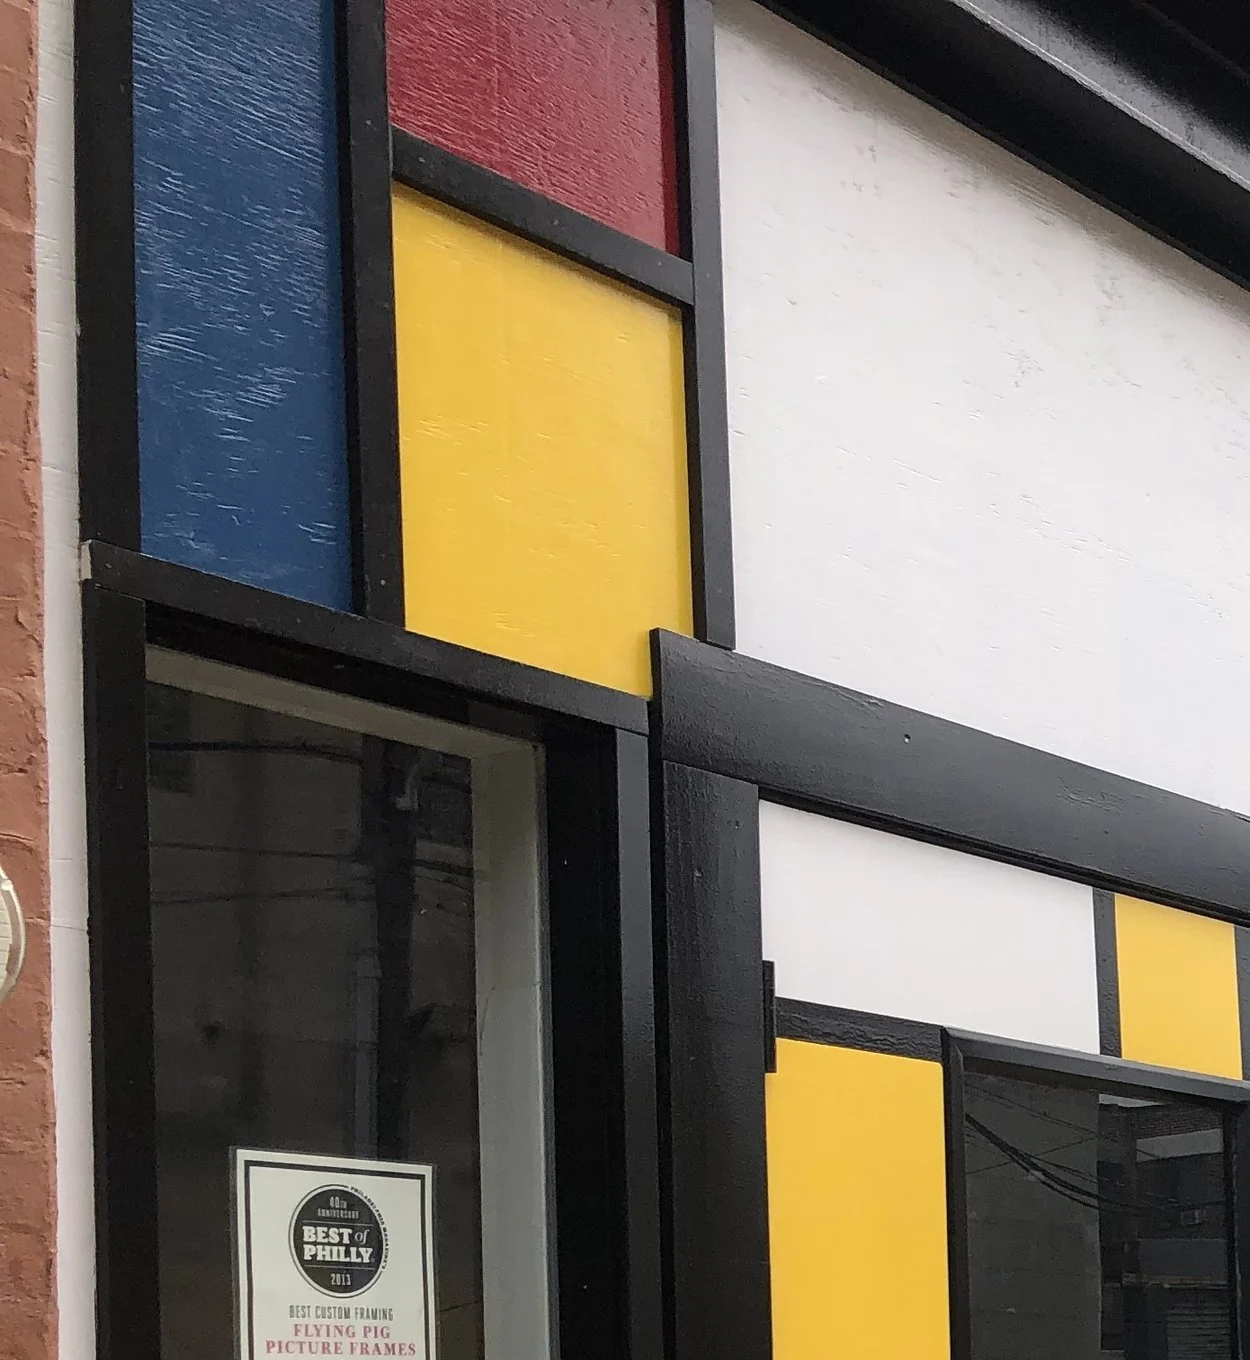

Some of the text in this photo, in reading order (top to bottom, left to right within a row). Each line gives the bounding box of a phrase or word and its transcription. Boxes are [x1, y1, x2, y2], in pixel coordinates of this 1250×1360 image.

[302, 1226, 370, 1245] BEST of
[302, 1244, 374, 1263] PHILLY
[330, 1273, 351, 1285] 2013
[289, 1304, 394, 1321] BEST CUSTOM FRAMING
[293, 1323, 391, 1339] FLYING PIG
[265, 1340, 416, 1357] PICTURE FRAMES
